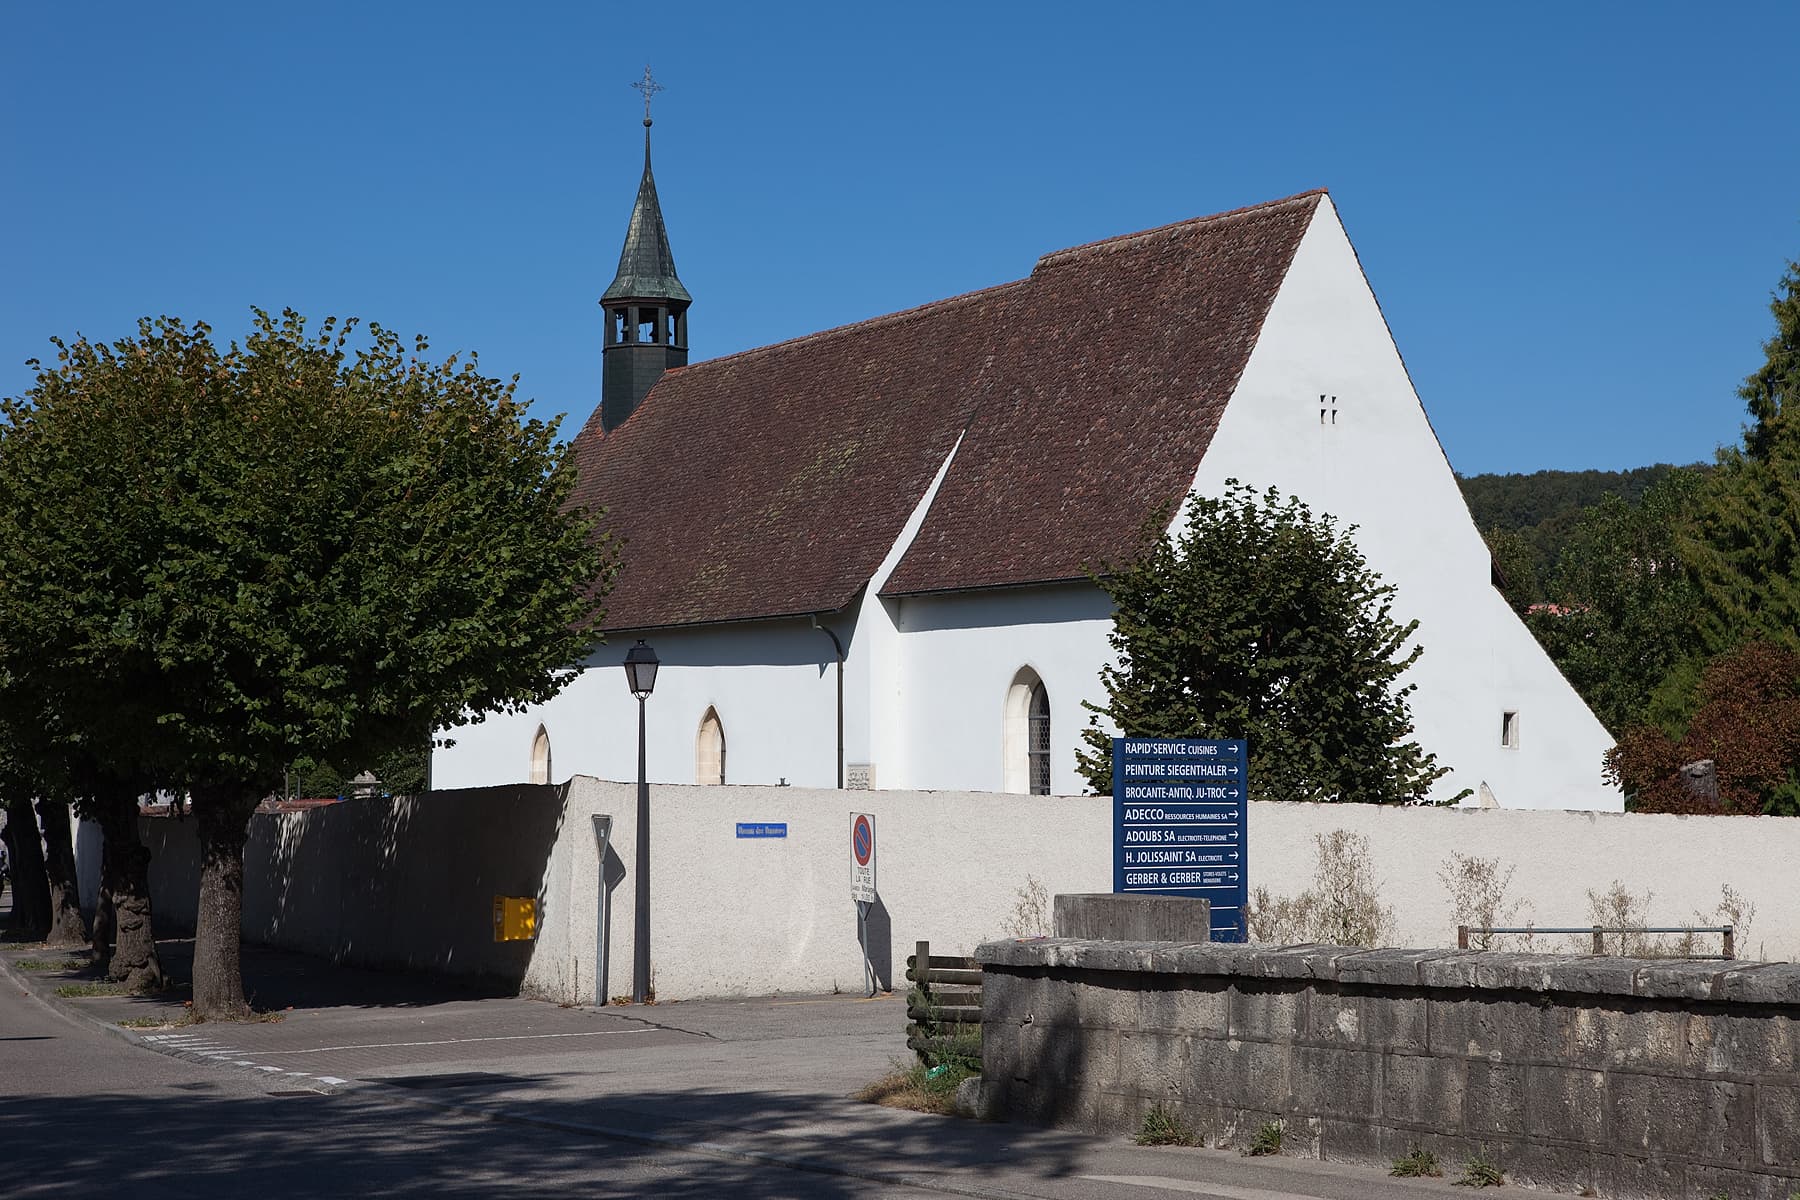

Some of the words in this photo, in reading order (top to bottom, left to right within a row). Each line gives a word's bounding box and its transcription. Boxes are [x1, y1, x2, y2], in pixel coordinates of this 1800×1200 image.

[1125, 743, 1186, 754] RAPID'SERVICE
[1188, 745, 1218, 755] CUISINES
[1125, 764, 1165, 776] PEINTURE
[1167, 764, 1227, 776] SIEGENTHALER
[1125, 787, 1194, 800] BROCANTE-ANTIQ.
[1195, 787, 1227, 799] JU-TROC
[1124, 809, 1164, 820] ADECCO
[1126, 831, 1162, 842] ADOUBS
[1164, 830, 1176, 842] SA
[1125, 852, 1135, 863] H.
[1136, 851, 1183, 863] JOLISSAINT
[1185, 851, 1196, 862] SA
[857, 866, 870, 876] TOUTE
[855, 874, 861, 883] LA
[863, 876, 871, 885] RUE
[1126, 873, 1159, 884] GERBER
[1160, 872, 1168, 884] &
[1169, 872, 1201, 883] GERBER
